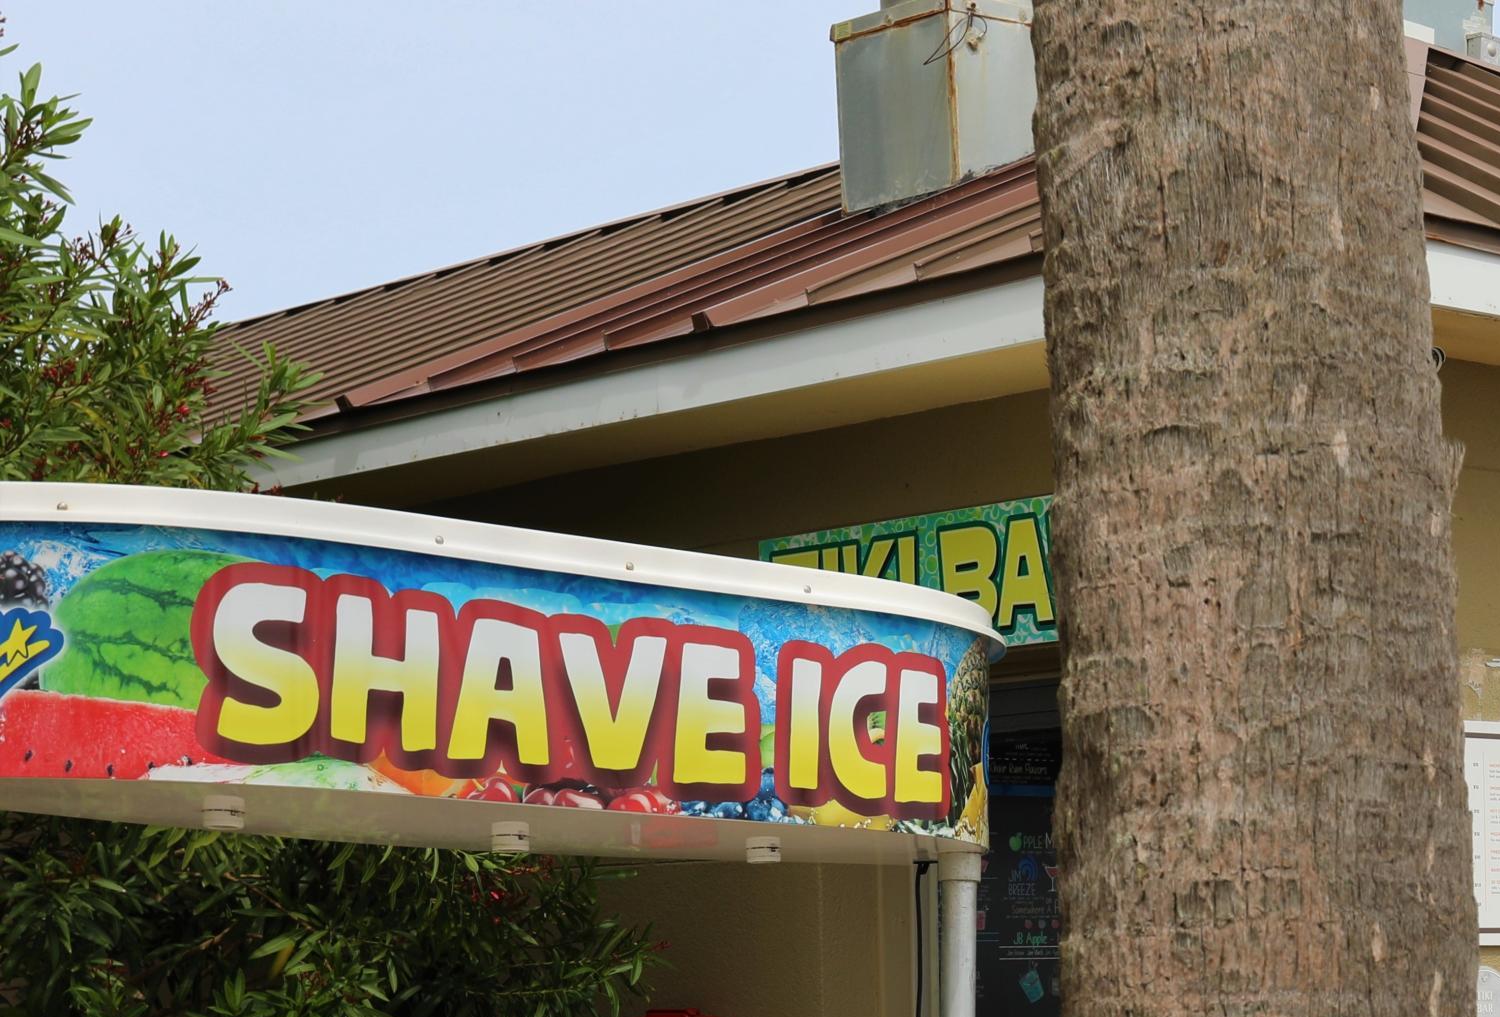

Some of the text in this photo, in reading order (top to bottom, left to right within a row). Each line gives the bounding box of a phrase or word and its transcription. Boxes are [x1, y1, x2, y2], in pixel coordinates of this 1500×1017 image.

[937, 514, 1056, 629] BA
[206, 575, 945, 809] SHAVE ICE
